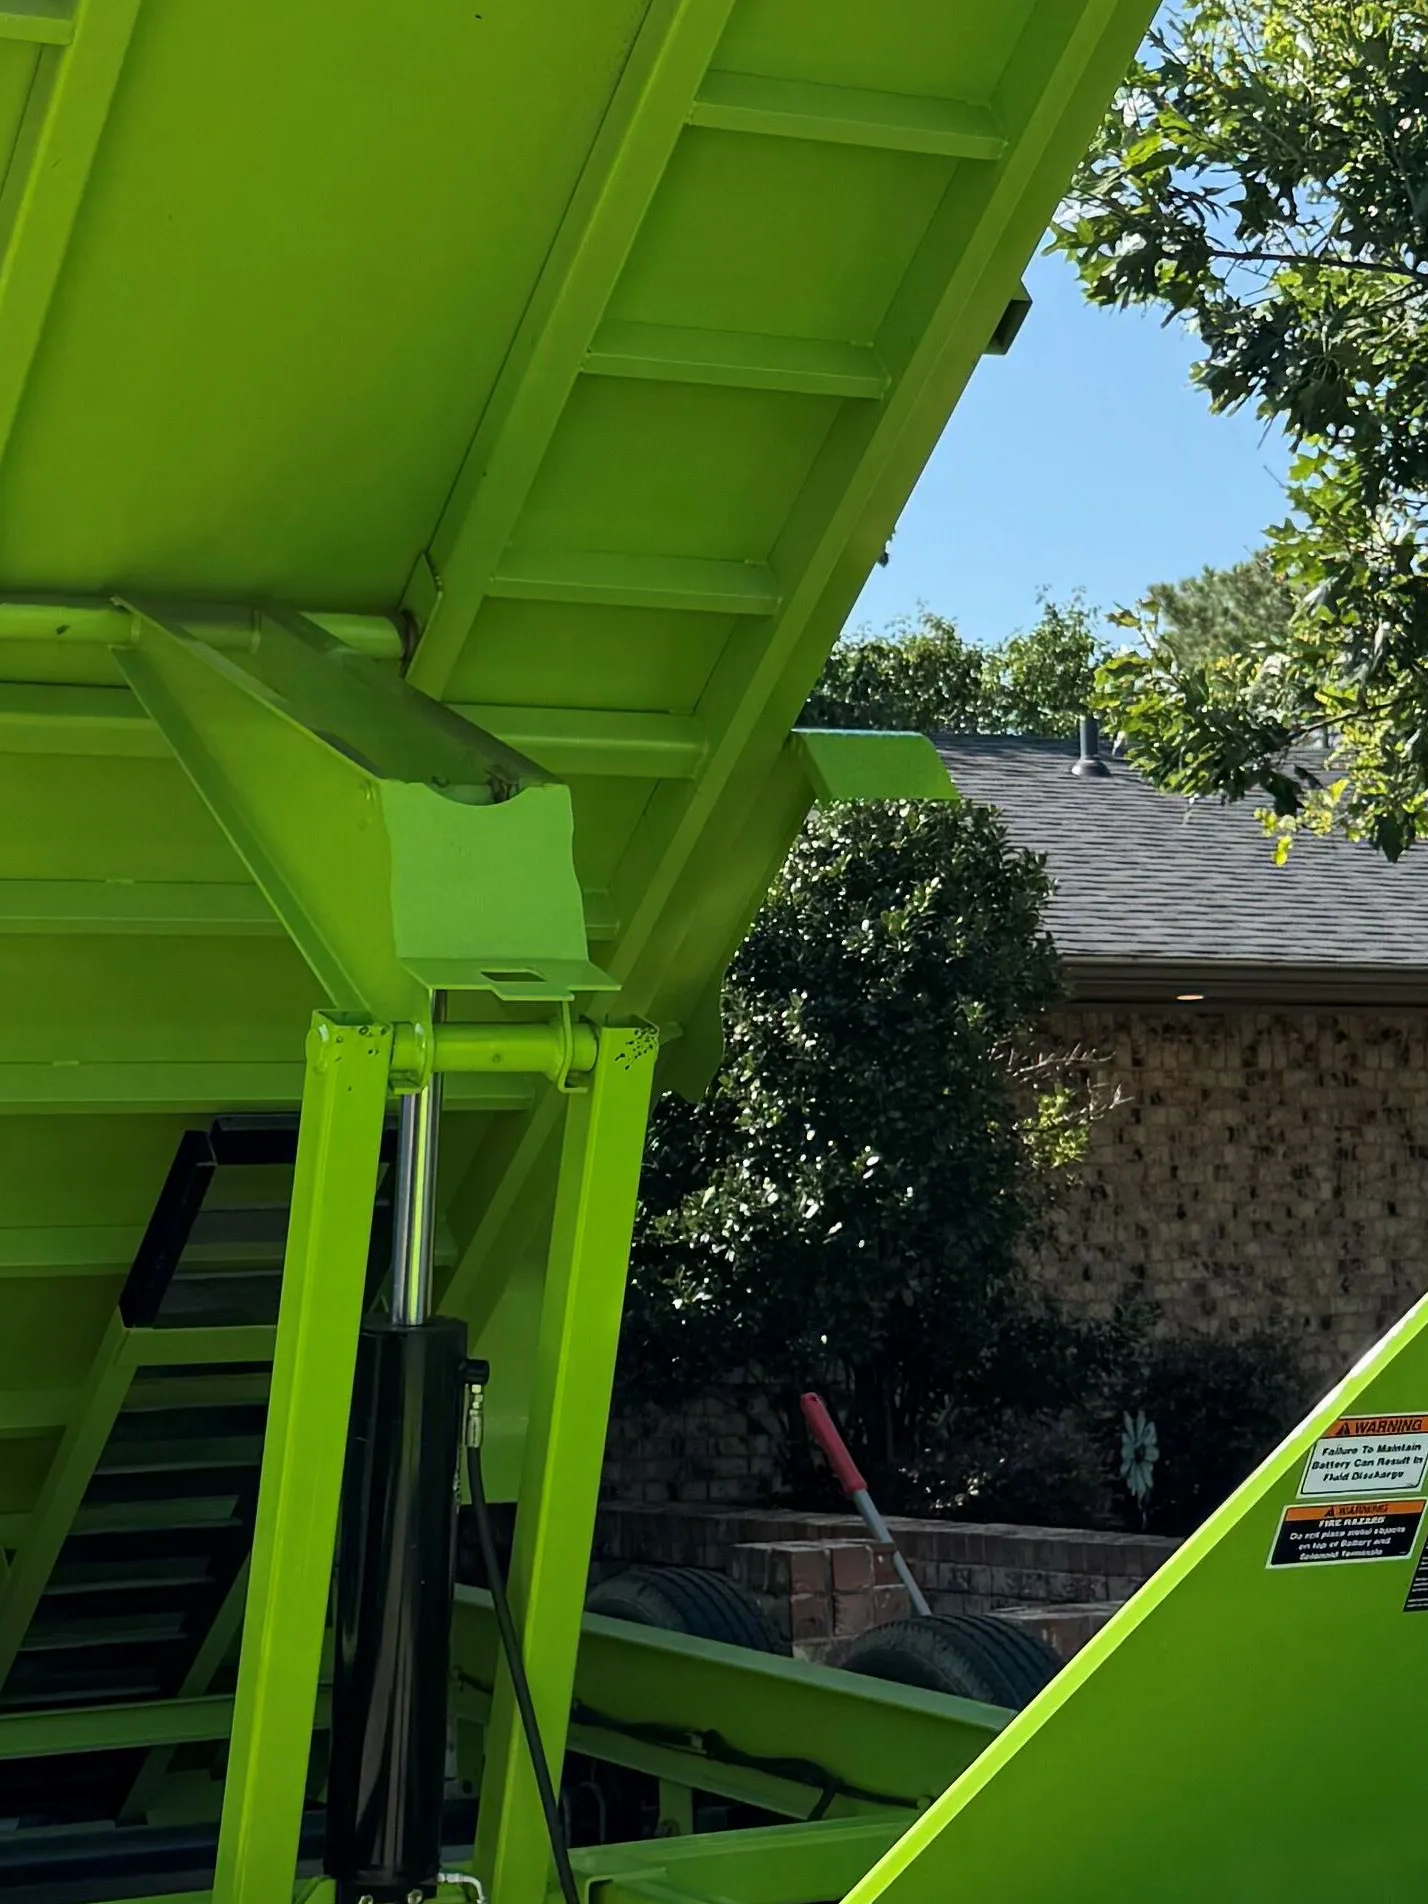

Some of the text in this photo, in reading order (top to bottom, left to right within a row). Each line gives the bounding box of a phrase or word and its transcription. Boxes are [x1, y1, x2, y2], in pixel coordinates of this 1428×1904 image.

[1355, 1419, 1423, 1434] WARNING
[1322, 1443, 1422, 1456] Failure To Maintain
[1311, 1460, 1350, 1470] Battery
[1354, 1458, 1374, 1467] Can
[1377, 1456, 1411, 1466] Result
[1323, 1470, 1404, 1481] Fluid Discharge
[1339, 1504, 1389, 1515] WARNING
[1319, 1516, 1386, 1527] FIRE HAZARD
[1289, 1532, 1303, 1540] Do
